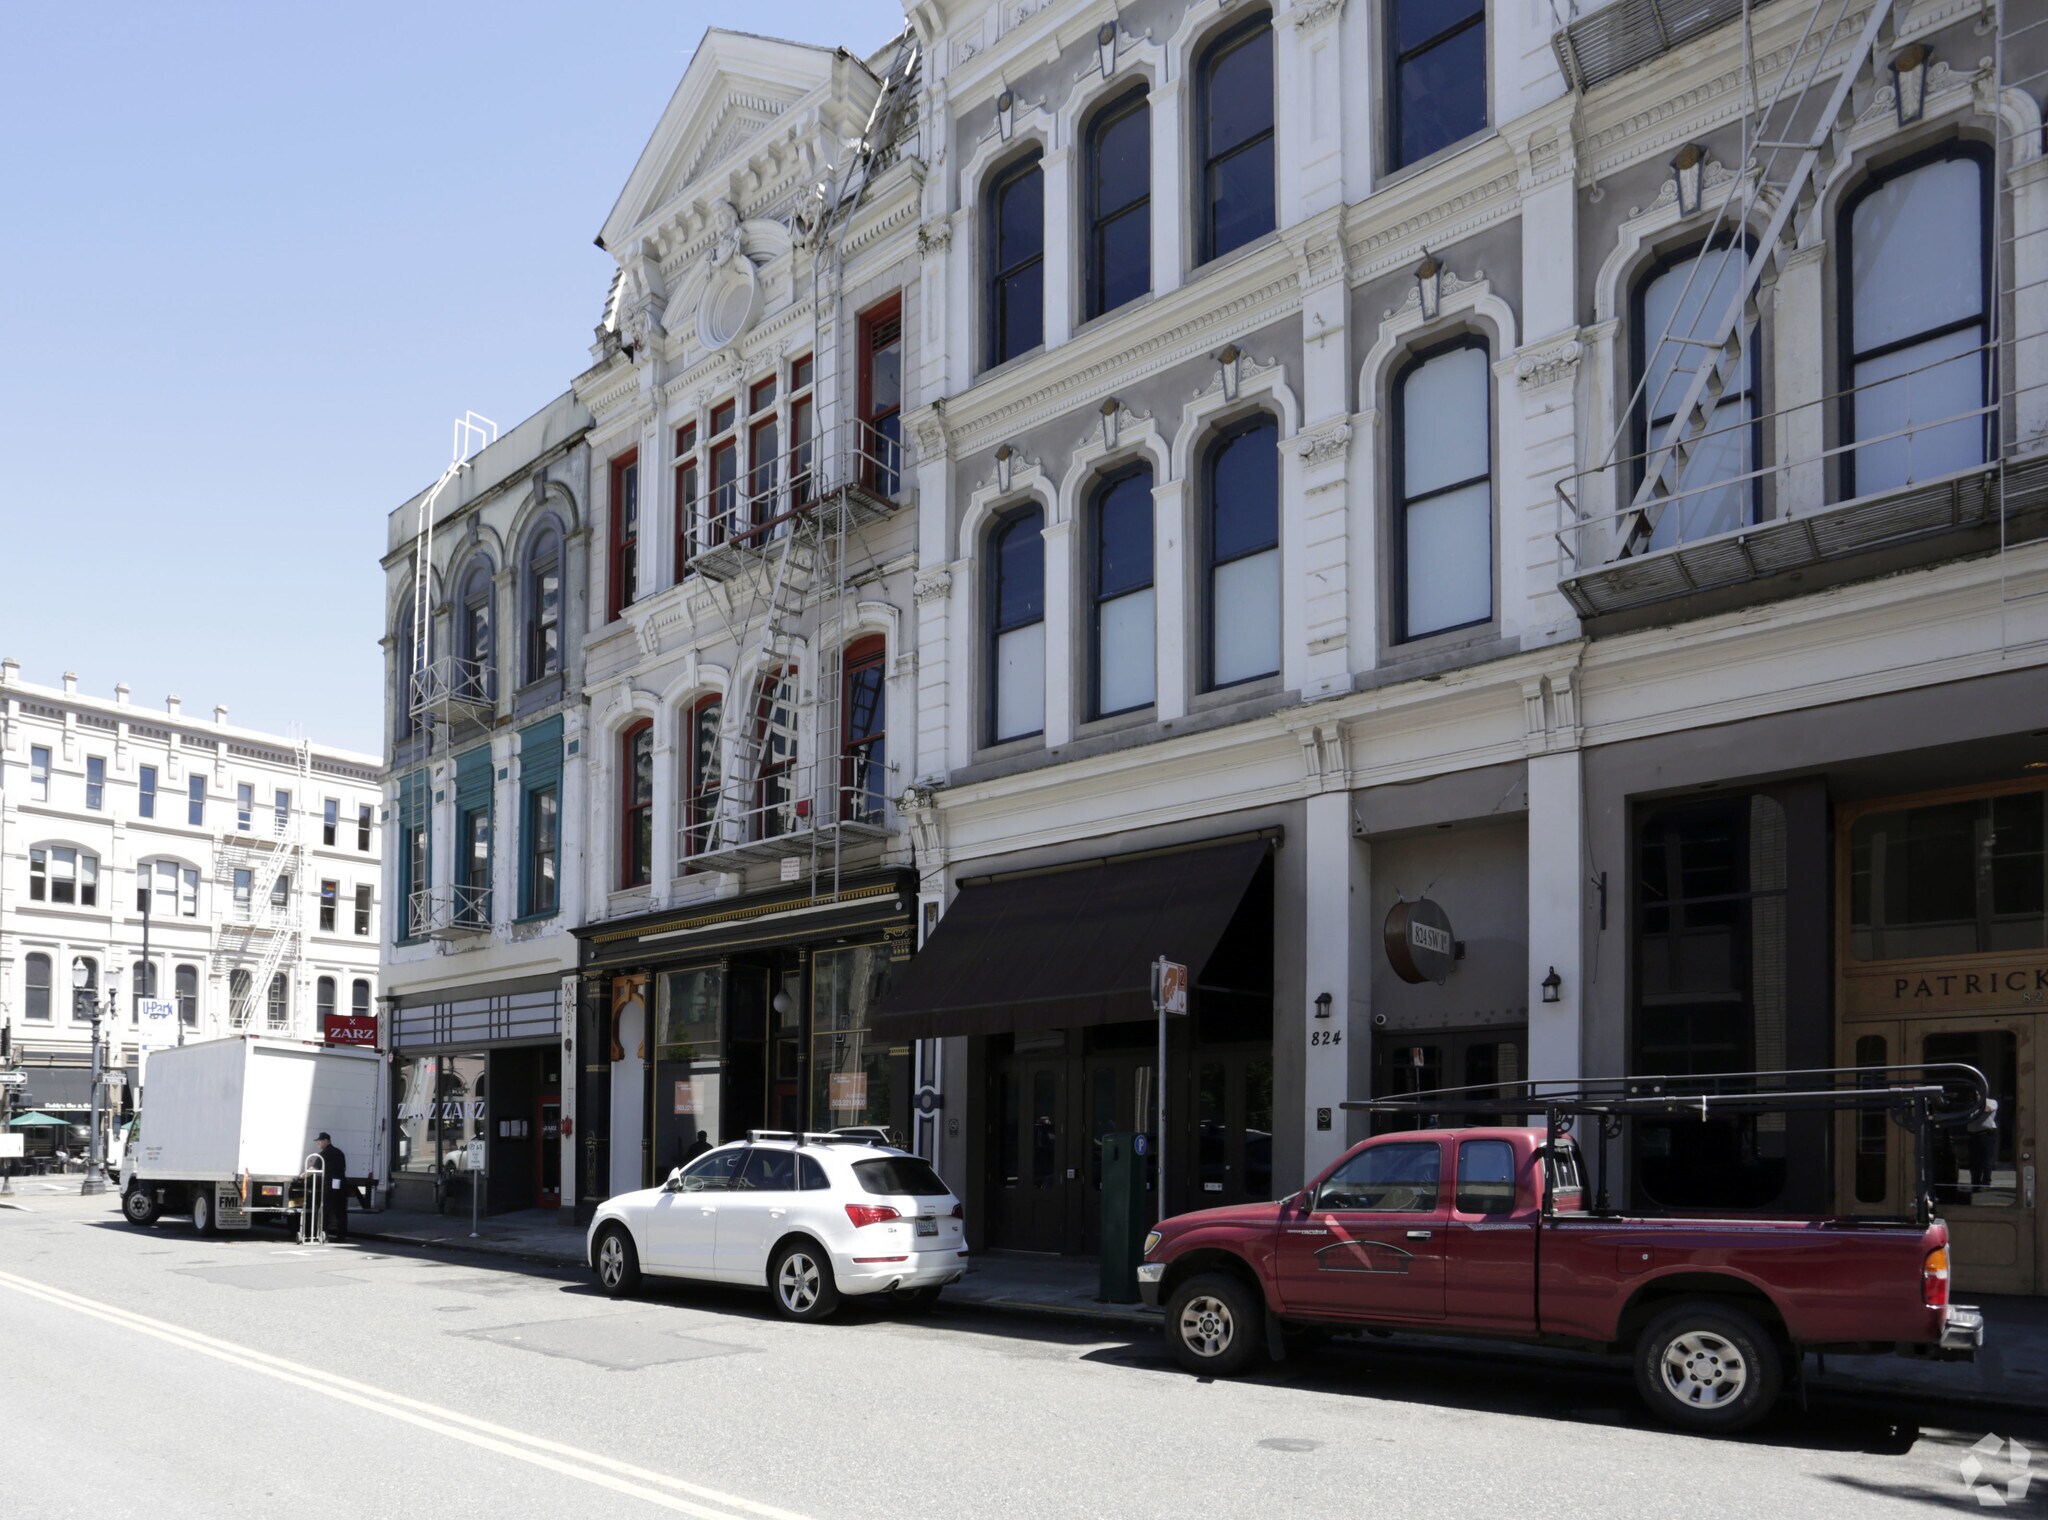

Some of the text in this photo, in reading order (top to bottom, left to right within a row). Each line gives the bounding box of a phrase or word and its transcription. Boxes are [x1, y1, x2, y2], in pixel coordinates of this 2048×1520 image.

[1415, 926, 1427, 945] 824
[1428, 930, 1439, 949] SW
[1894, 969, 2048, 998] PATRICK
[143, 1001, 173, 1014] U-Park
[331, 1028, 374, 1039] ZARZ
[1311, 1030, 1341, 1046] 824
[397, 1103, 436, 1119] ZARZ
[442, 1102, 485, 1120] ZARZ
